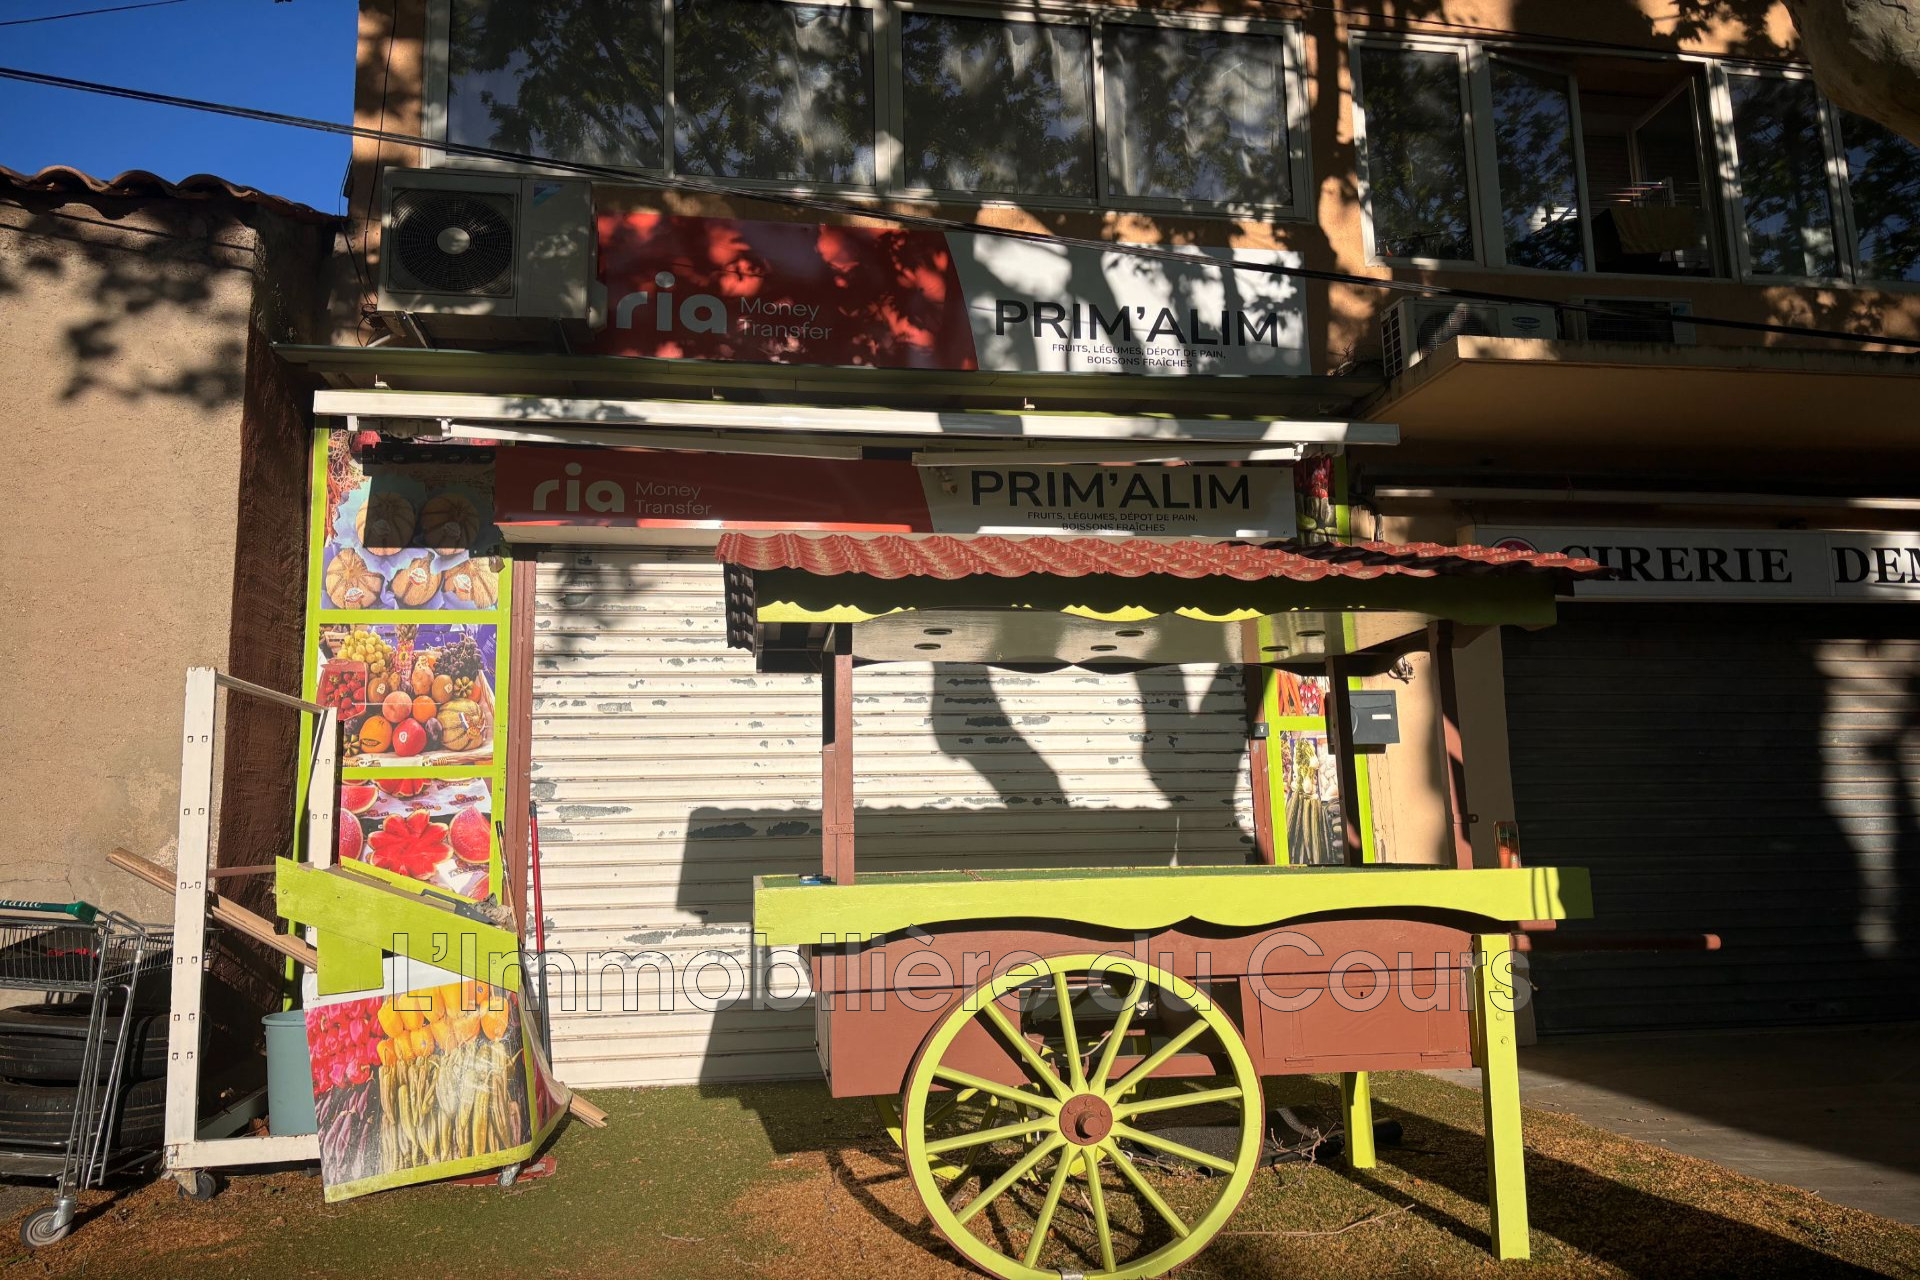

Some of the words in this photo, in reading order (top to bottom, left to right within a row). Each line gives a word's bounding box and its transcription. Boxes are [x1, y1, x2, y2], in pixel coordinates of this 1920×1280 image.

[616, 271, 728, 334] ria
[740, 297, 820, 320] Money
[739, 318, 833, 340] Transfer
[995, 299, 1279, 348] PRIM'ALIM
[1052, 344, 1091, 354] FRUITS,
[1093, 344, 1144, 356] LÉGUMES,
[1183, 350, 1197, 358] DE
[1199, 350, 1227, 359] PAIN,
[1087, 355, 1140, 366] BOISSONS
[1142, 357, 1193, 368] FRAÎCHES
[533, 462, 625, 513] ria
[635, 481, 701, 499] Money
[971, 470, 1250, 510] PRIM'ALIM
[634, 499, 712, 515] Transfer
[1027, 511, 1065, 521] FRUITS,
[1067, 510, 1118, 522] LÉGUMES,
[1156, 512, 1169, 522] DE
[1172, 513, 1198, 524] PAIN,
[1062, 522, 1114, 531] BOISSONS
[1116, 522, 1165, 532] FRAÎCHES
